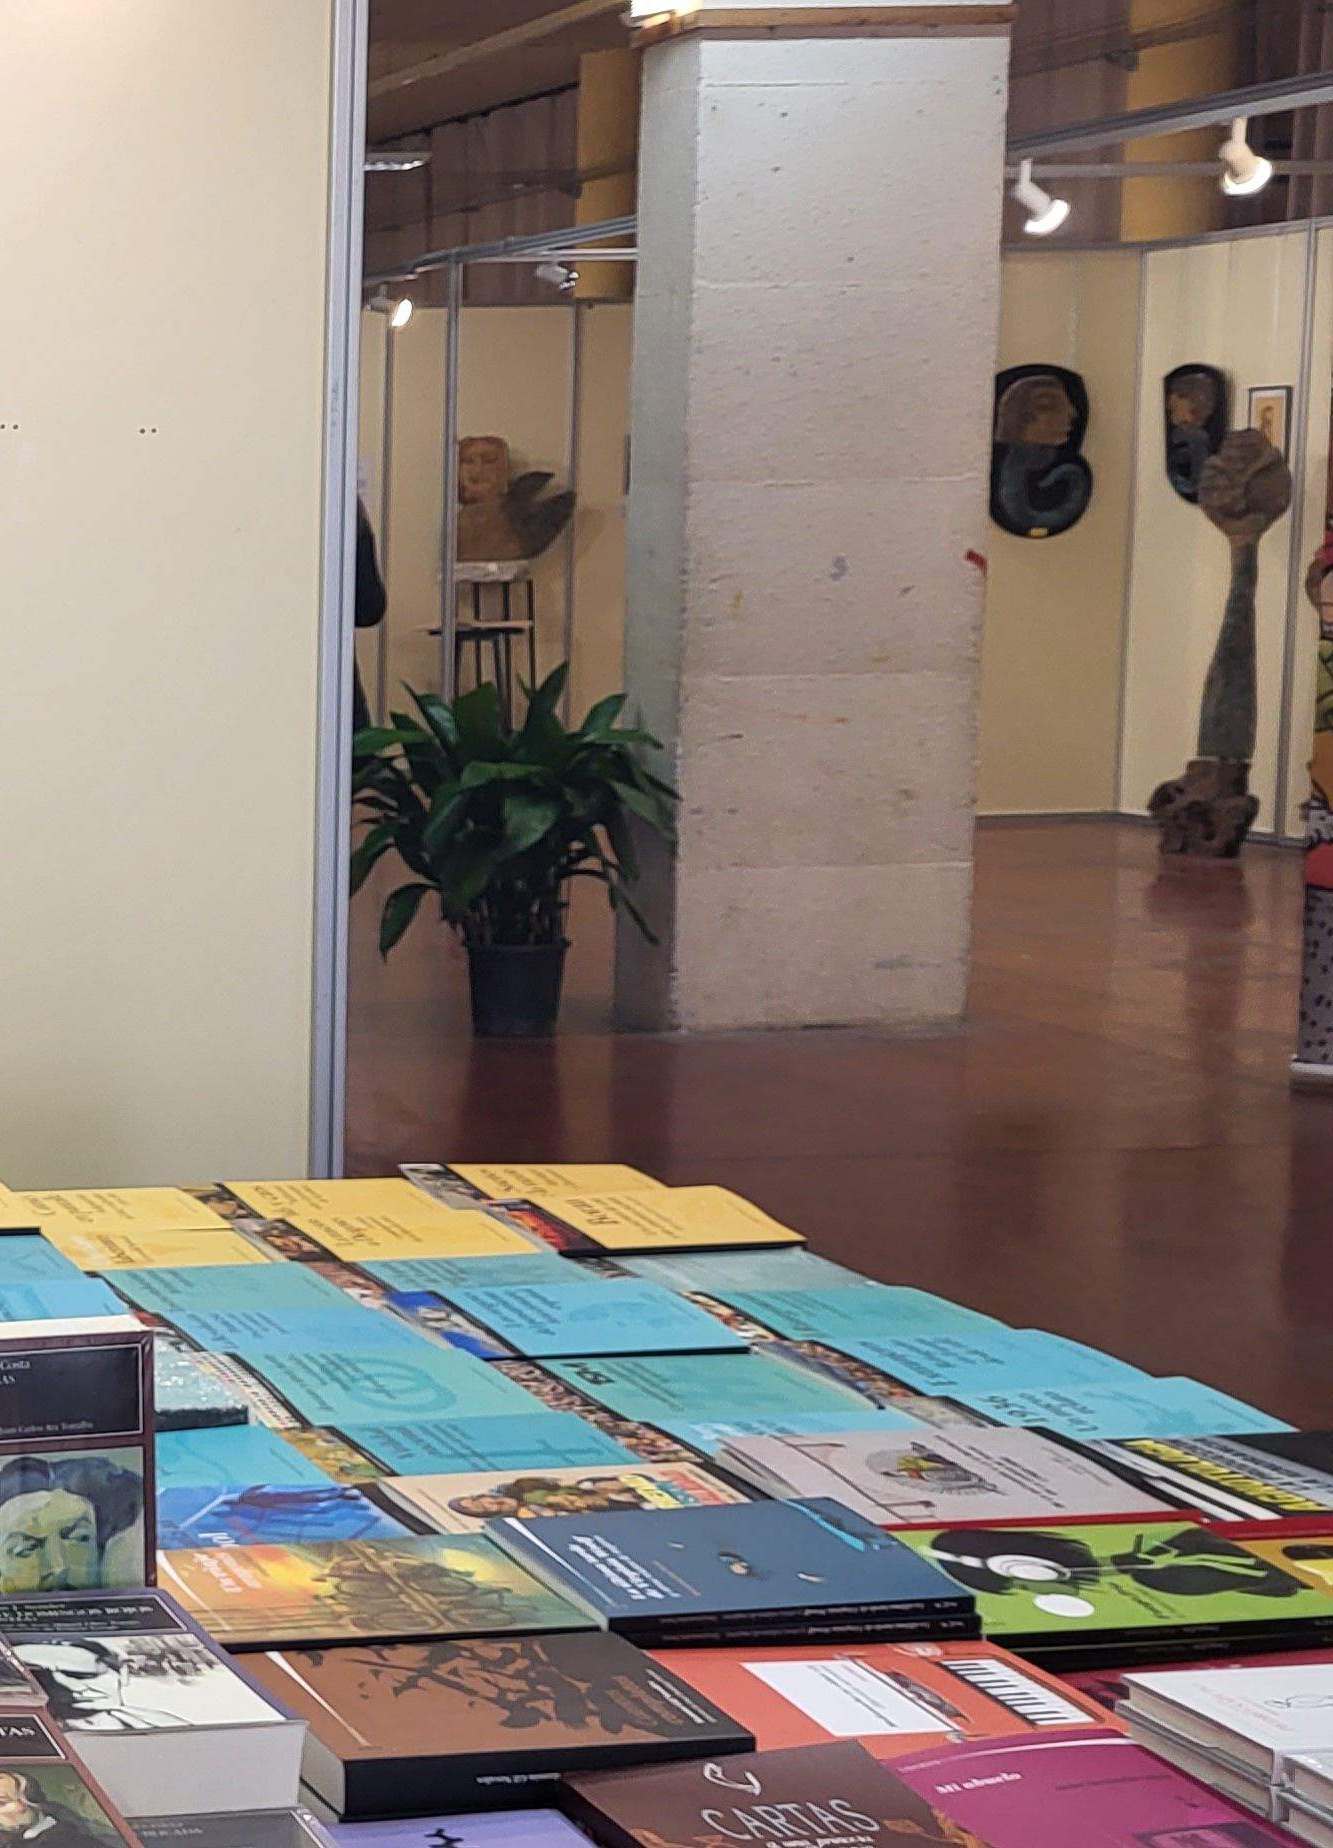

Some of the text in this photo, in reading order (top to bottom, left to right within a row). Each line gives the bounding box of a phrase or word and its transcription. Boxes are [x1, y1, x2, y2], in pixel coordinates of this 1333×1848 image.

[0, 1360, 31, 1371] Costa
[935, 1772, 1022, 1795] Mi abuelo
[700, 1799, 880, 1841] CARTAS
